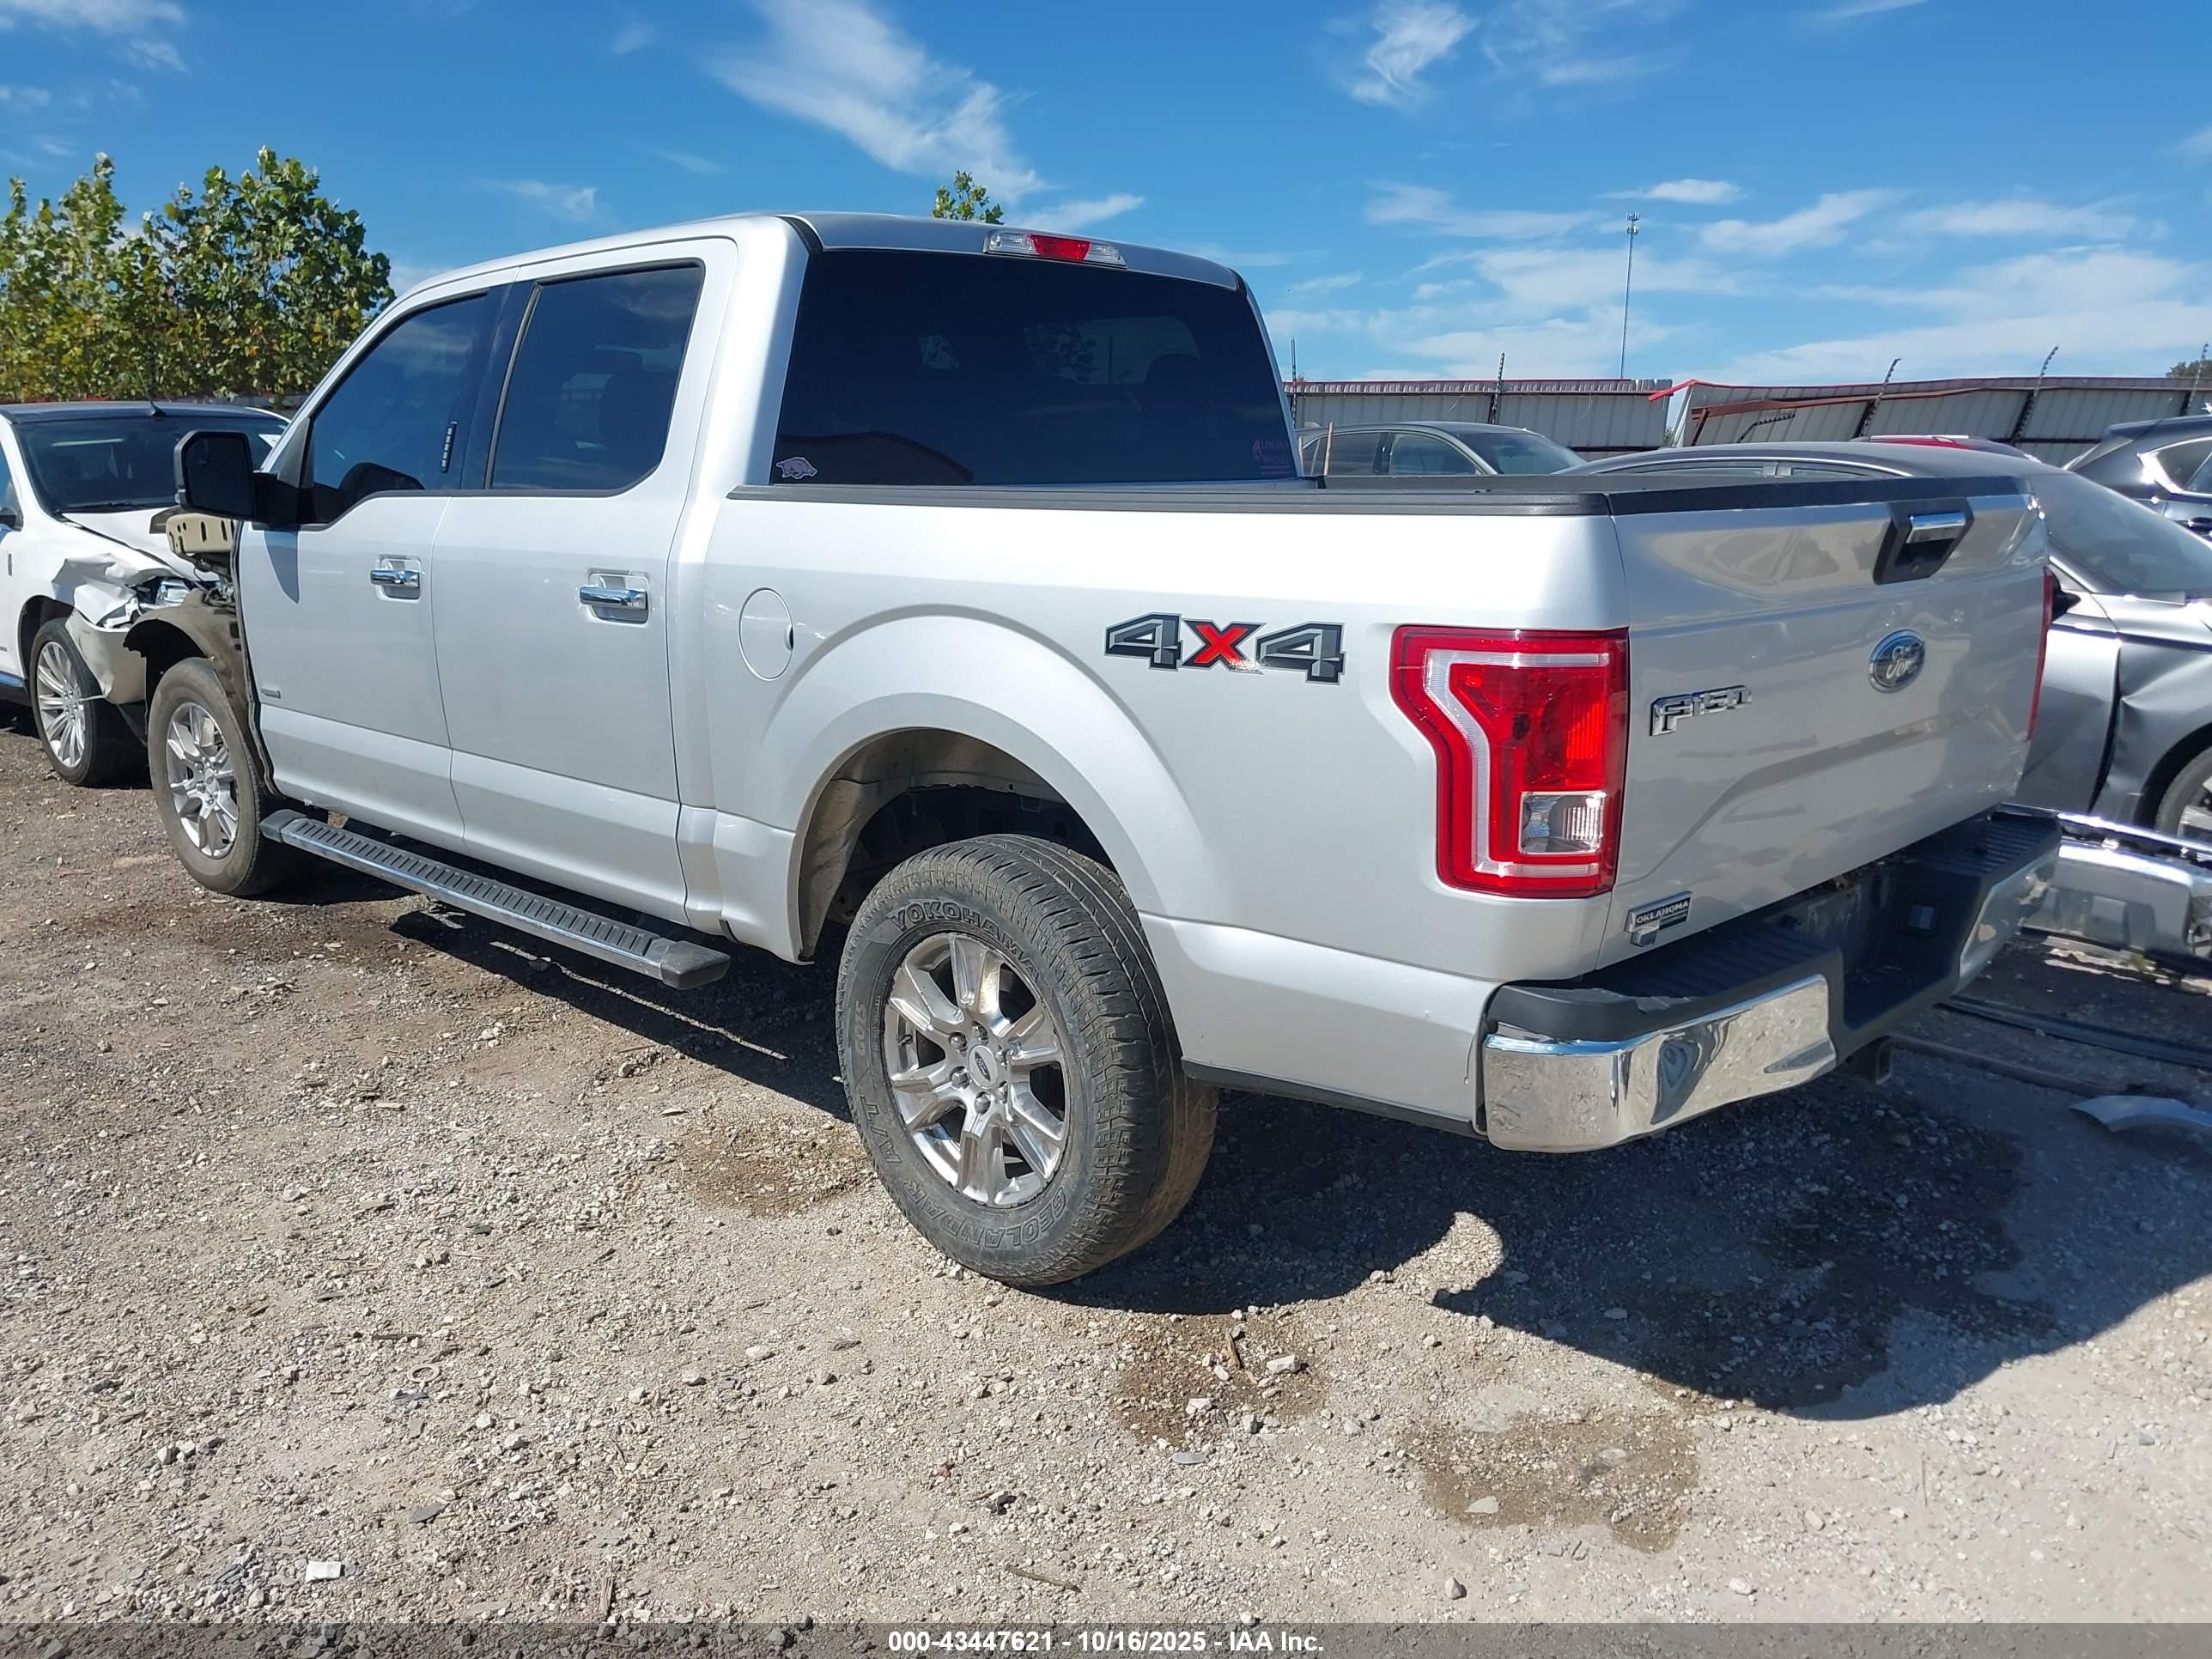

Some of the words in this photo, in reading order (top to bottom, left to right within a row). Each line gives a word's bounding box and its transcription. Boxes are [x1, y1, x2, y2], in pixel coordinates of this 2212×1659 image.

[888, 901, 1041, 985] YOKOHAMA
[1635, 900, 1689, 925] OKLAHOMA
[902, 1179, 1066, 1249] GEOLANDAR
